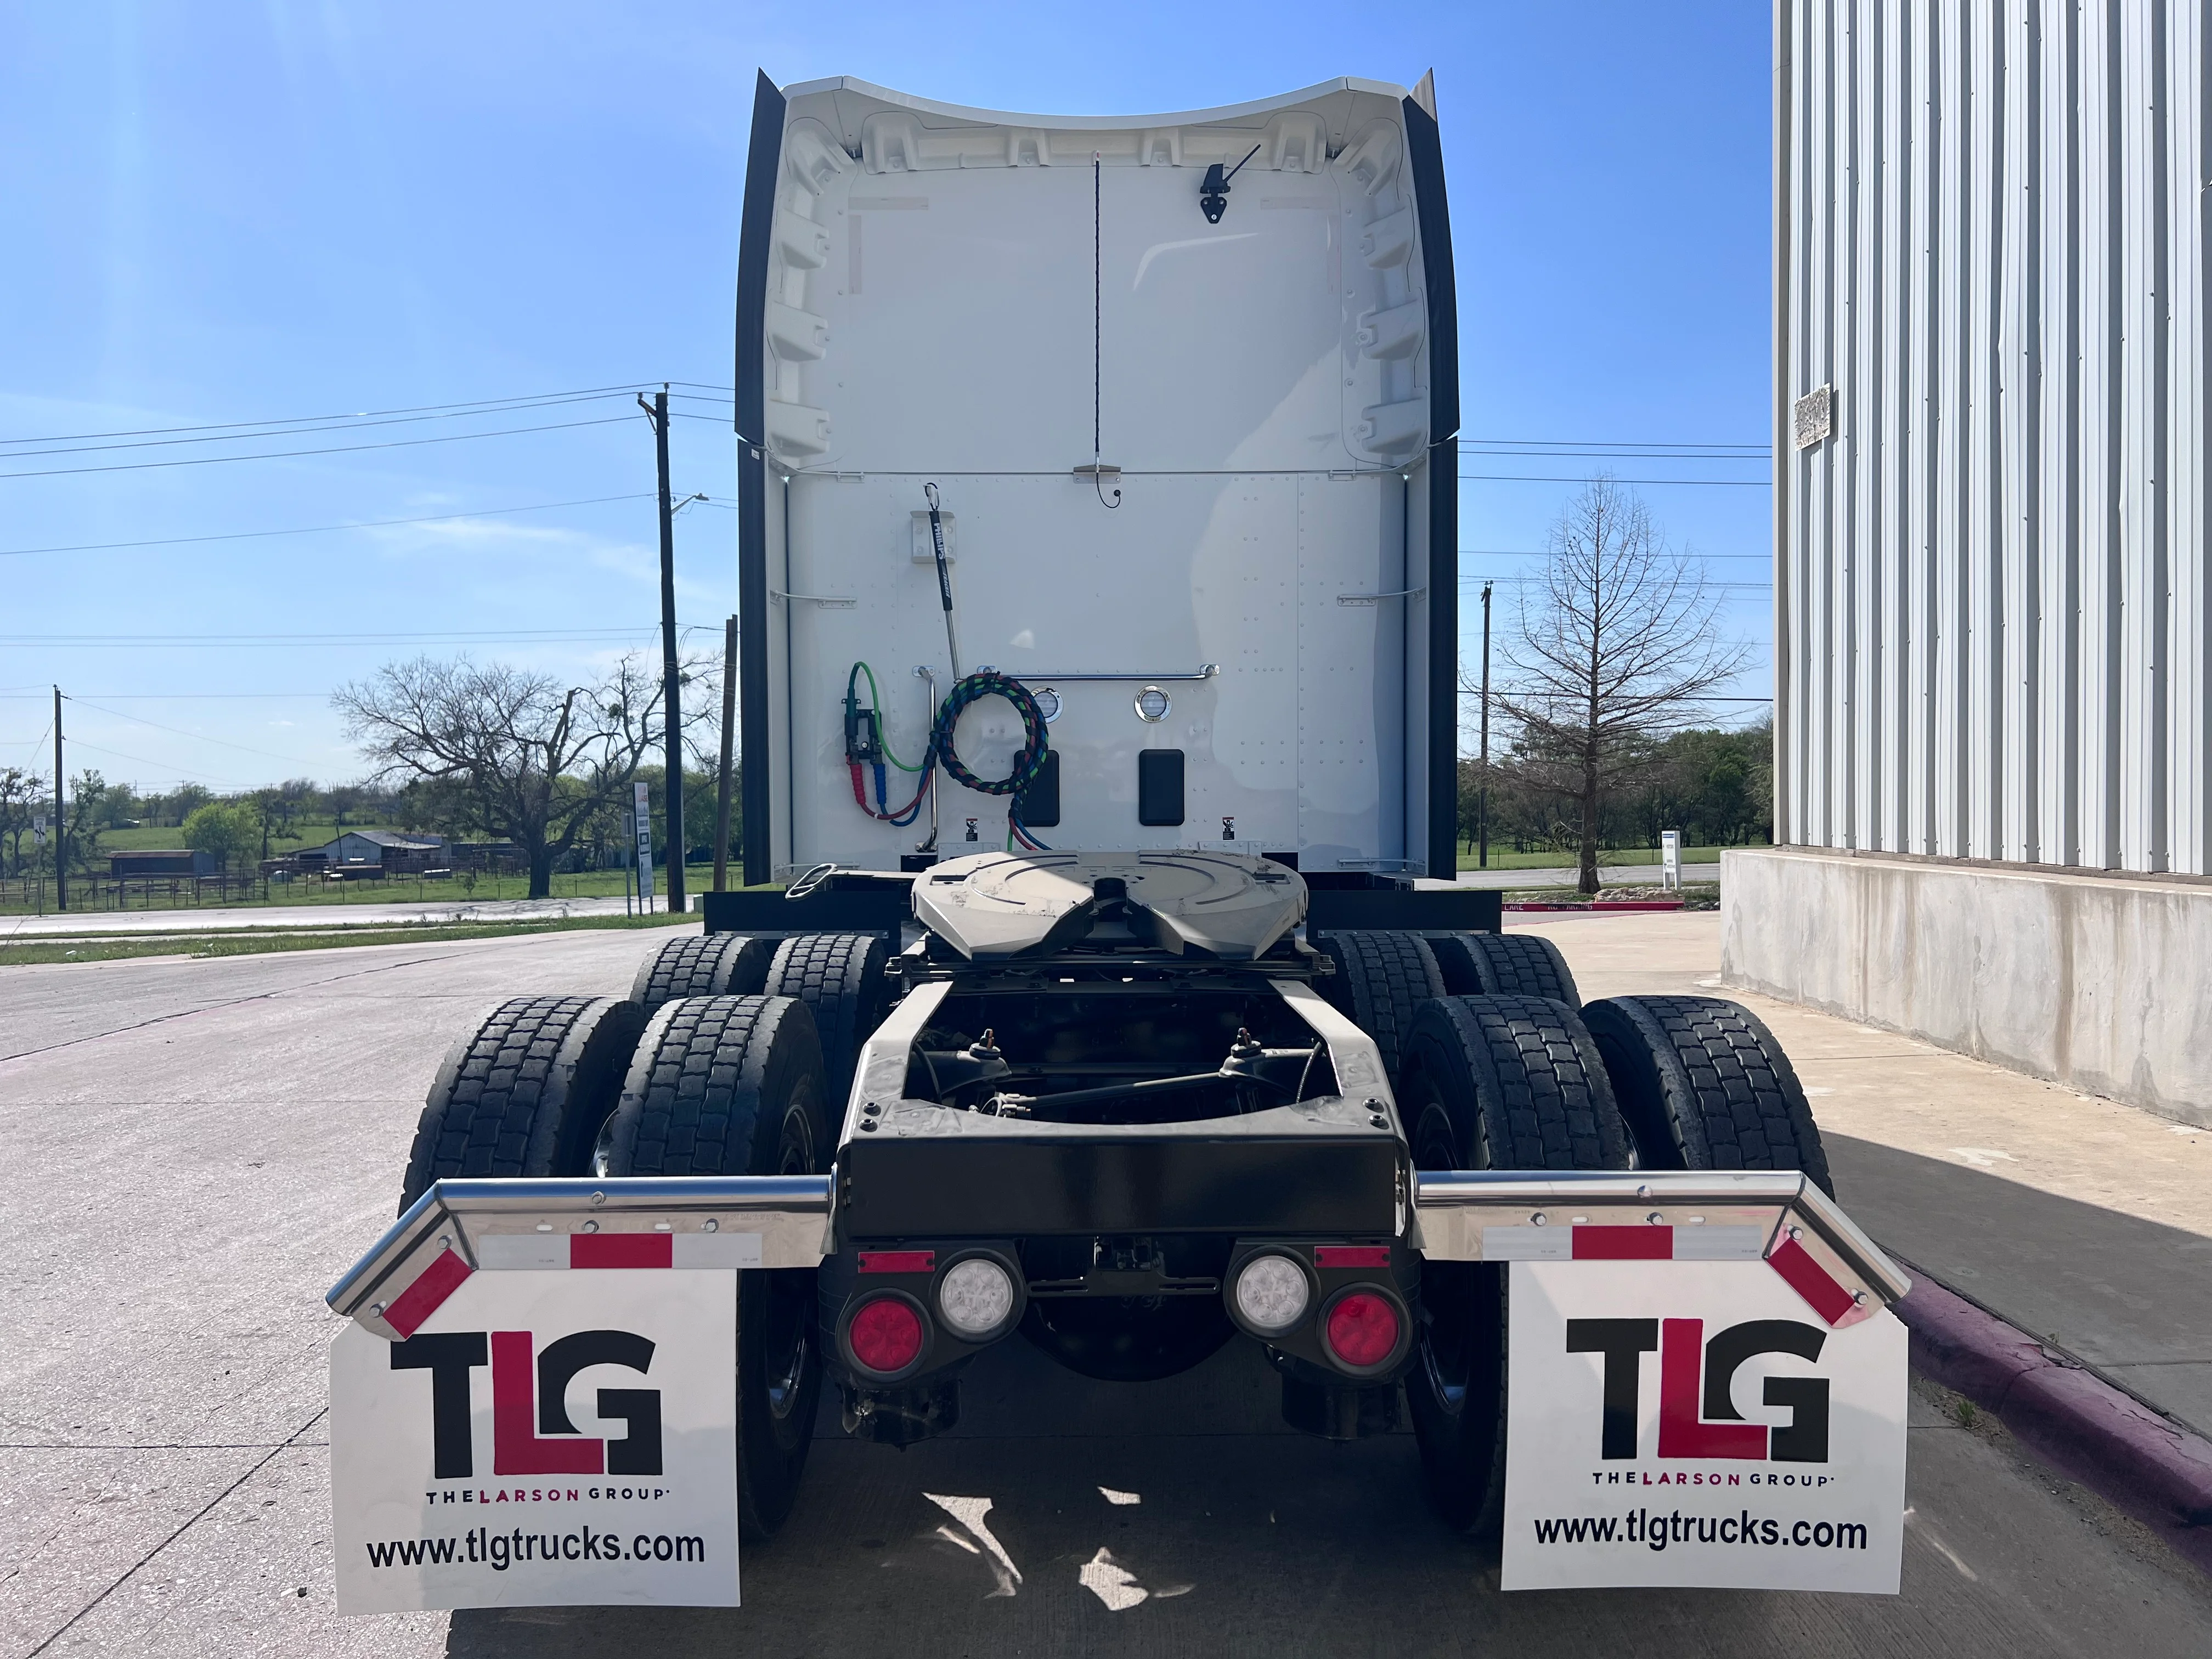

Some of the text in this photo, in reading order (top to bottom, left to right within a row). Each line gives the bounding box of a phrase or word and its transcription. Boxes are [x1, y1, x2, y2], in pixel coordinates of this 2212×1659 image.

[934, 522, 945, 560] PHILLIPS
[391, 1330, 663, 1479] TLG
[1566, 1318, 1830, 1463] TLG
[589, 1487, 663, 1500] GROUP
[1750, 1473, 1827, 1487] GROUP
[366, 1525, 705, 1571] www.tlgtrucks.com
[1534, 1508, 1867, 1551] www.tlgtrucks.com
